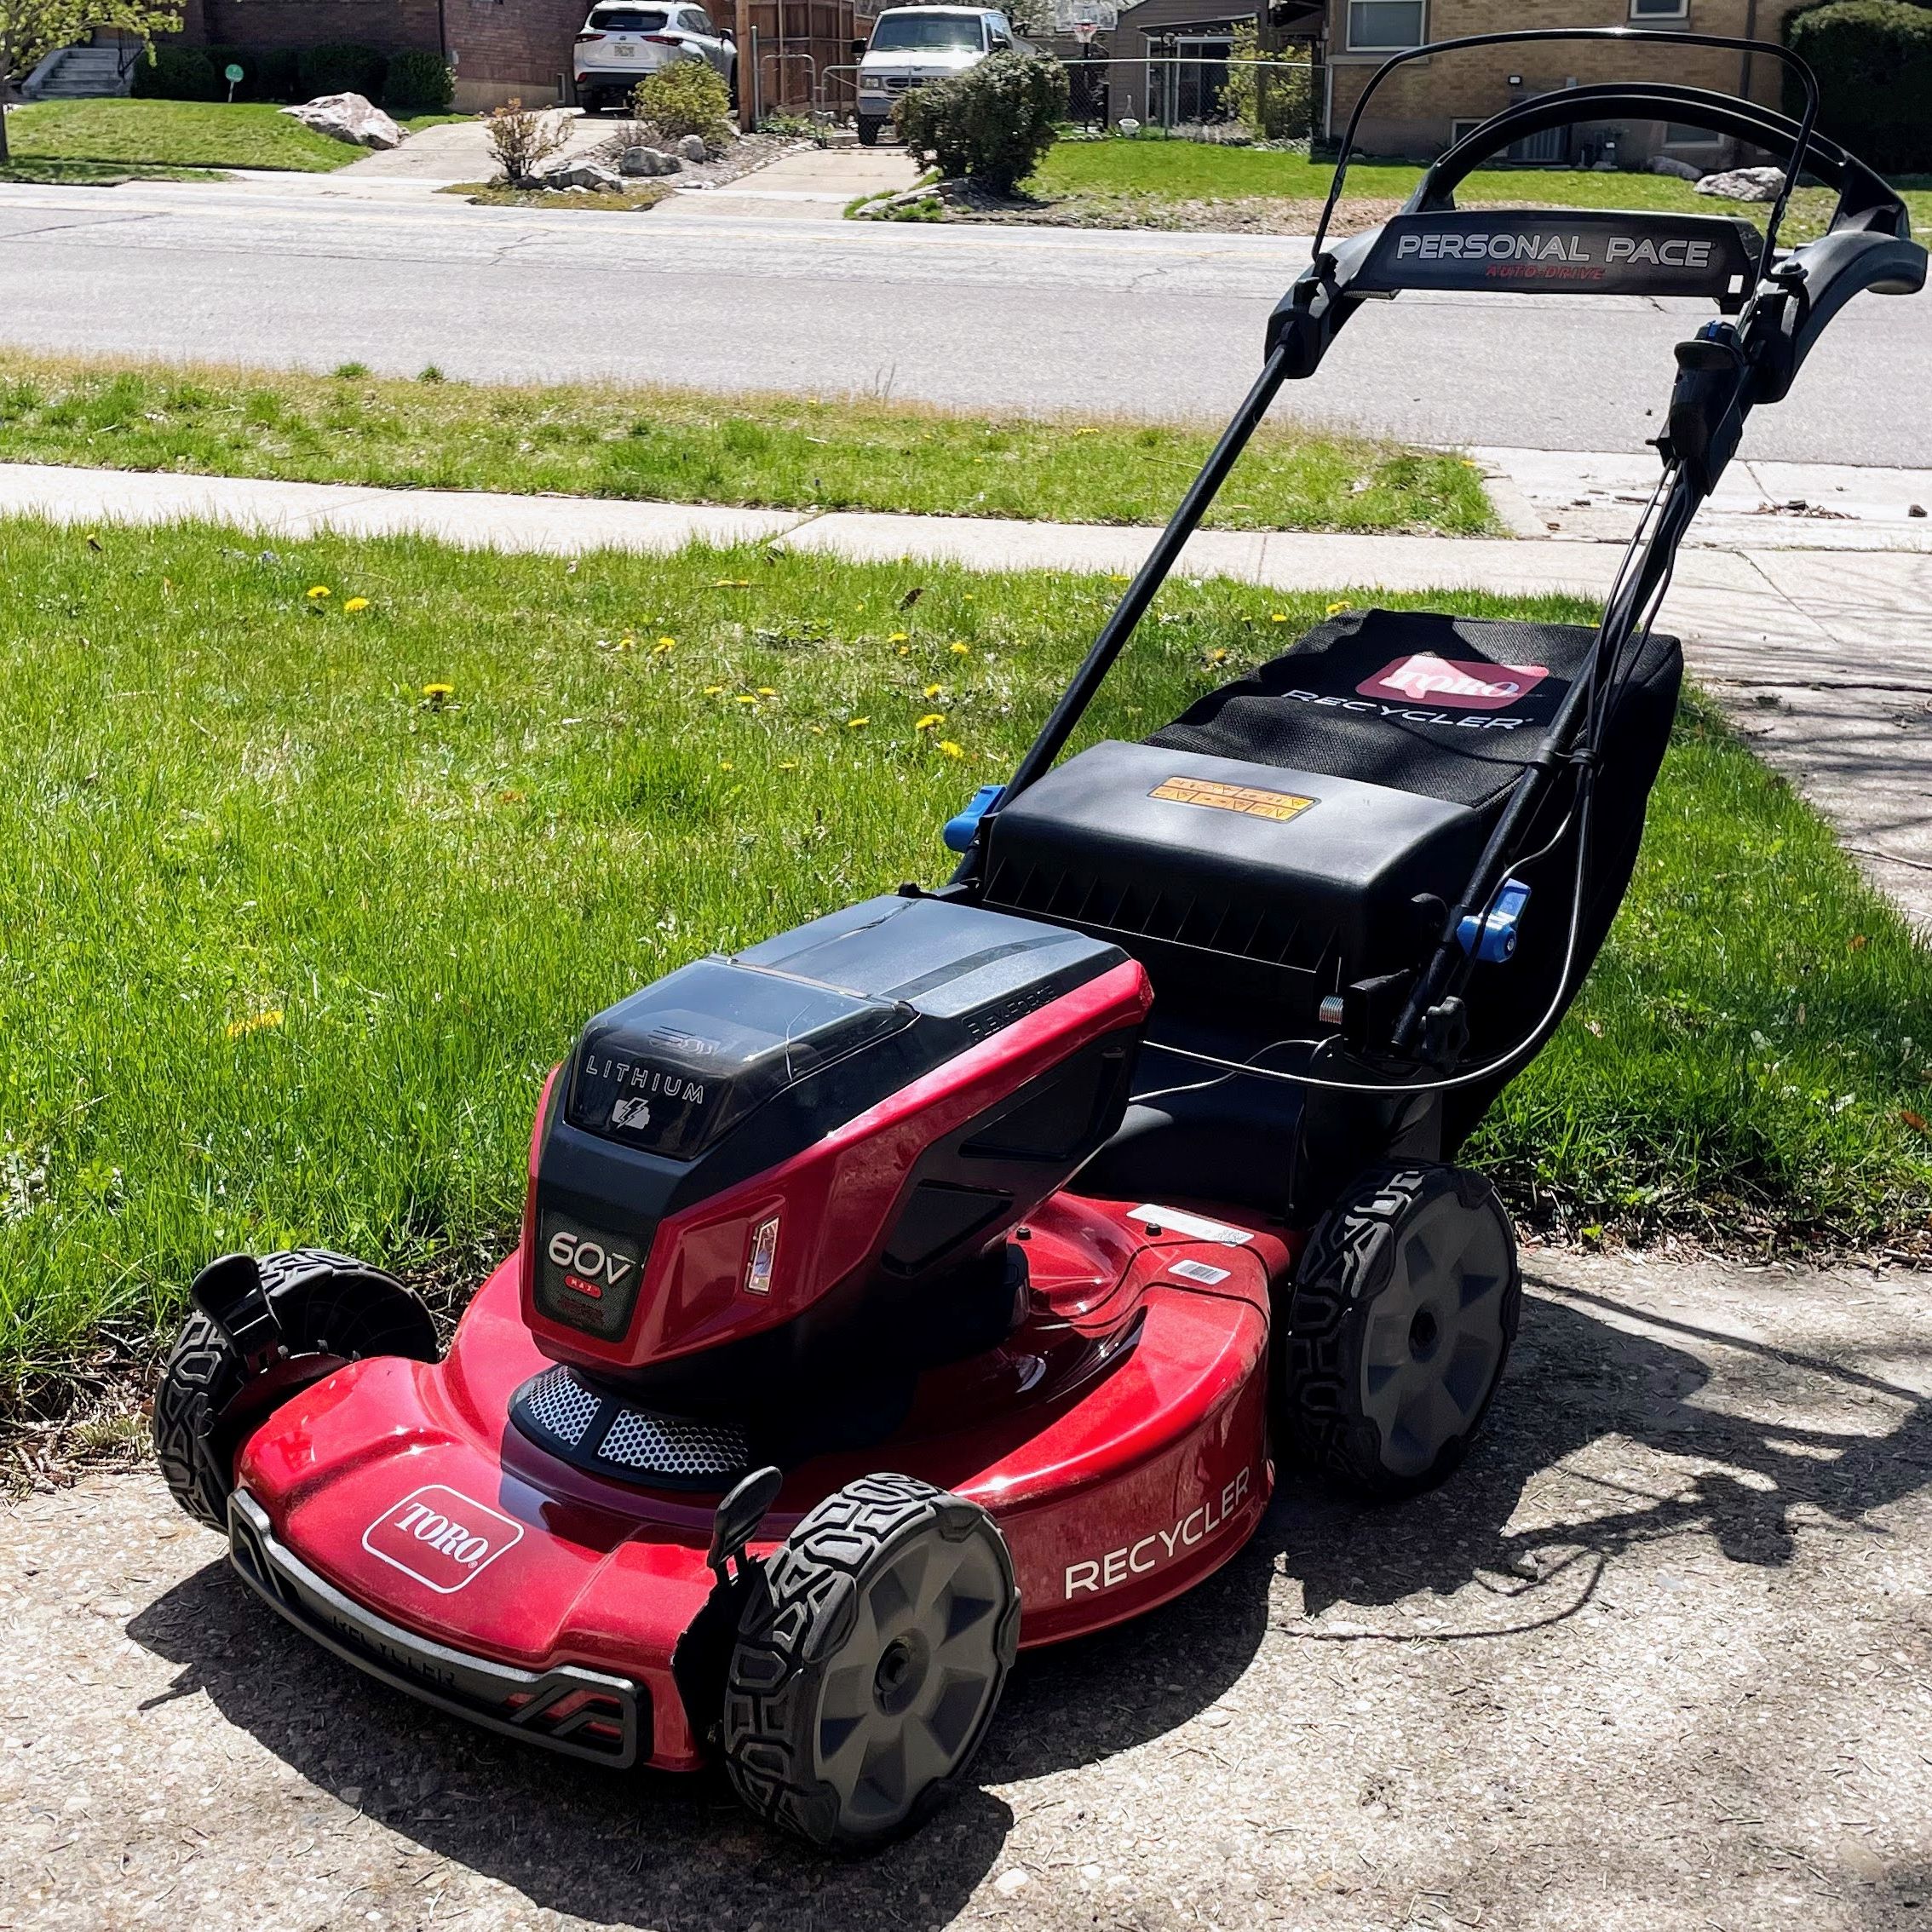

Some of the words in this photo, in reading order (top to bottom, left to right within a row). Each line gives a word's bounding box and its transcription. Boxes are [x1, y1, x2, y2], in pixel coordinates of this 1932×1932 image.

[1396, 234, 1590, 261] PERSONAL
[1605, 237, 1711, 267] PACE
[1378, 670, 1520, 699] TORO
[1280, 688, 1528, 730] RECYCLER
[585, 1055, 704, 1104] LITHIUM
[549, 1231, 636, 1285] 60V
[571, 1279, 593, 1291] MAX
[394, 1502, 489, 1563] TORO
[1065, 1466, 1251, 1601] RECYCLER
